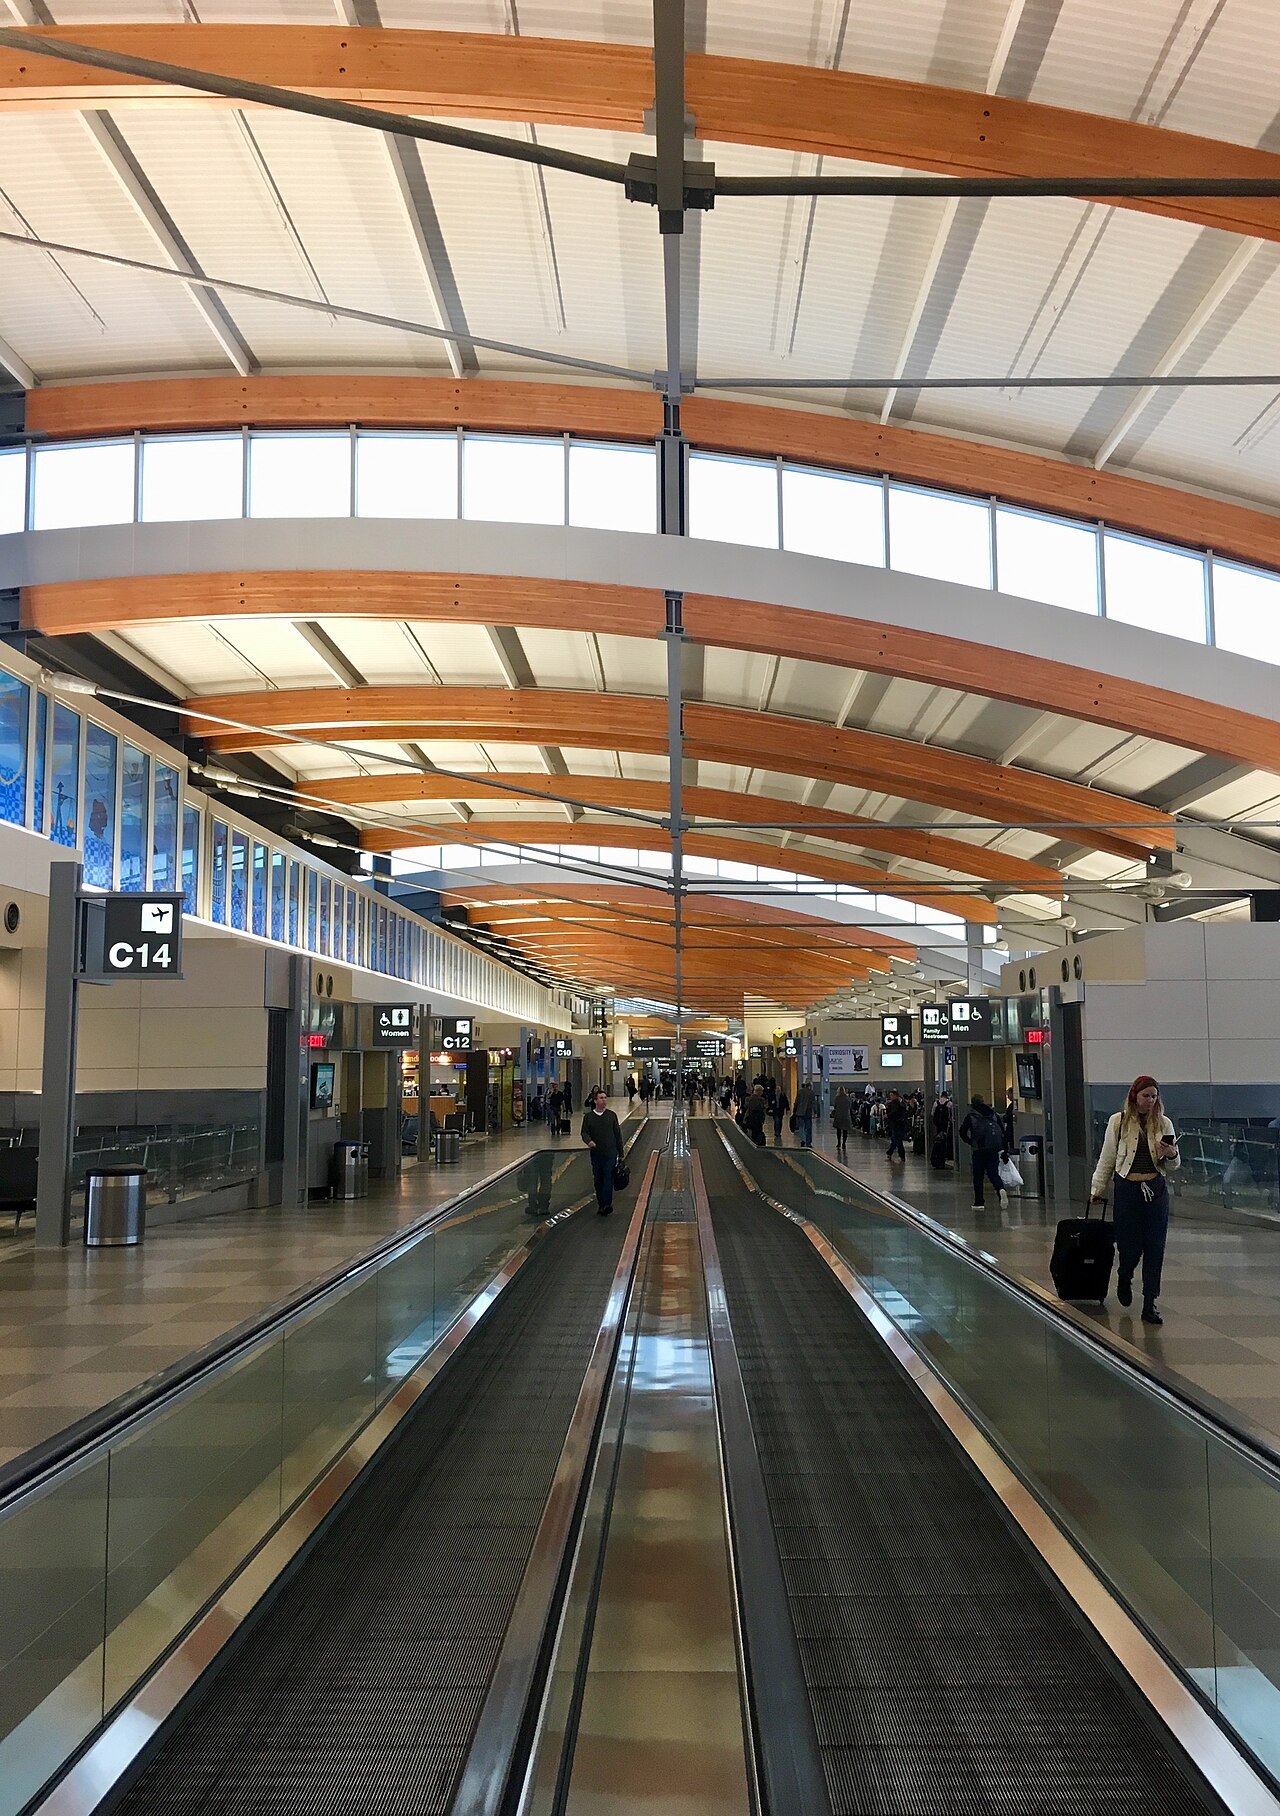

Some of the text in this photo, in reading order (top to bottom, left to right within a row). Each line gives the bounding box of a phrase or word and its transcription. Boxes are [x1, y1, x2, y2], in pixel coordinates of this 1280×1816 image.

[109, 942, 172, 968] C14
[381, 1029, 410, 1037] Women
[952, 1024, 969, 1032] Men
[309, 1035, 324, 1047] EXIT
[443, 1036, 470, 1048] C12
[884, 1034, 909, 1046] C11
[1028, 1031, 1042, 1043] EXIT
